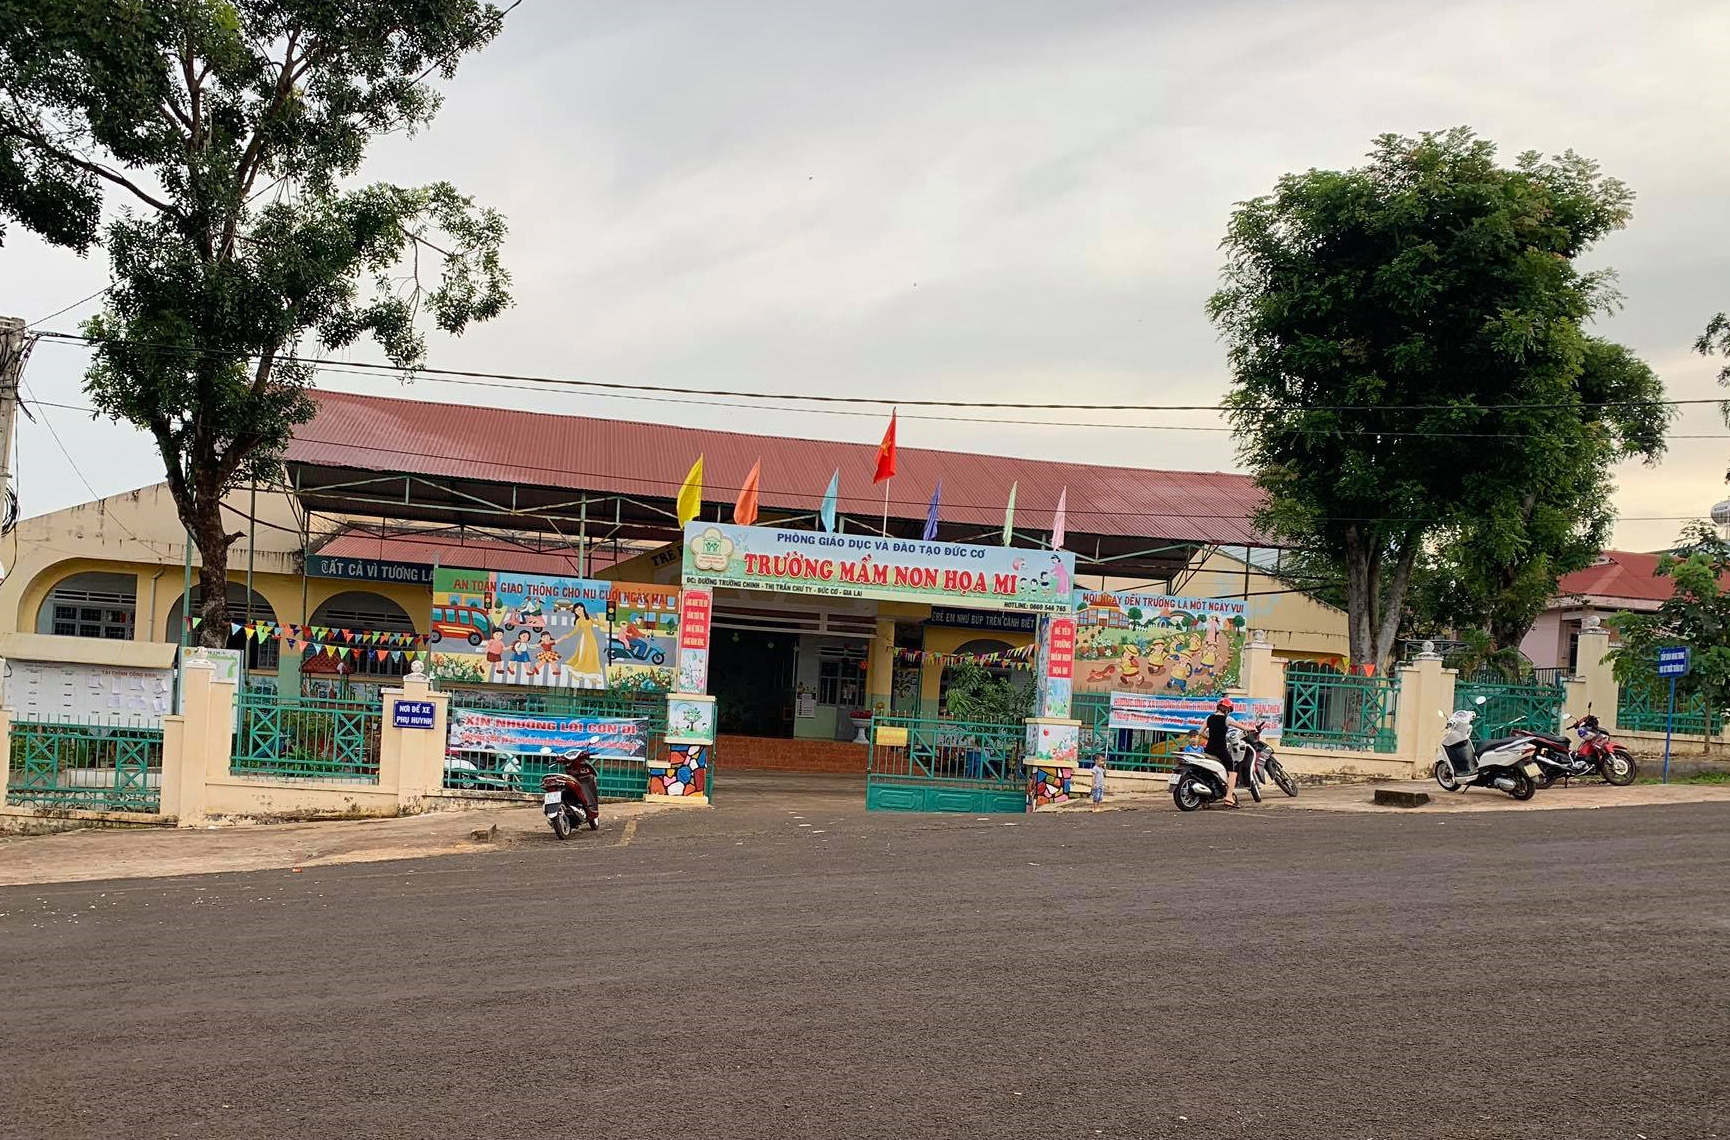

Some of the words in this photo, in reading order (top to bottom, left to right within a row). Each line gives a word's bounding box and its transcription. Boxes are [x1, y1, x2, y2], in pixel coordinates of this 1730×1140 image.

[777, 532, 815, 545] PHÒNG
[819, 536, 845, 547] GIÁO
[848, 539, 871, 550] DỤC
[875, 540, 889, 551] VÀ
[893, 542, 916, 553] ĐÀO
[919, 545, 941, 556] TẠO
[944, 546, 967, 557] ĐỨC
[970, 549, 985, 558] CƠ
[321, 559, 344, 574] TẤT
[348, 561, 364, 576] CẢ
[367, 563, 378, 577] VÌ
[744, 551, 833, 581] TRƯỜNG
[839, 554, 889, 586] MẦM
[894, 565, 939, 589] NON
[943, 569, 987, 595] HỌA
[993, 573, 1018, 594] MI
[454, 580, 468, 590] AN
[472, 577, 497, 592] TOÀN
[501, 582, 523, 594] GIAO
[527, 582, 560, 597] THÔNG
[562, 587, 581, 599] CHO
[583, 588, 597, 602] NỤ
[743, 581, 760, 589] CHINH
[1004, 601, 1029, 610] HOTLINE:
[1125, 593, 1140, 606] ĐẾN
[1143, 595, 1175, 608] TRƯỜNG
[1231, 604, 1244, 613] VUI
[422, 706, 430, 714] XE
[397, 715, 409, 725] PHỤ
[411, 716, 432, 725] HUYNH
[465, 715, 491, 727] XIN
[587, 723, 617, 734] CON
